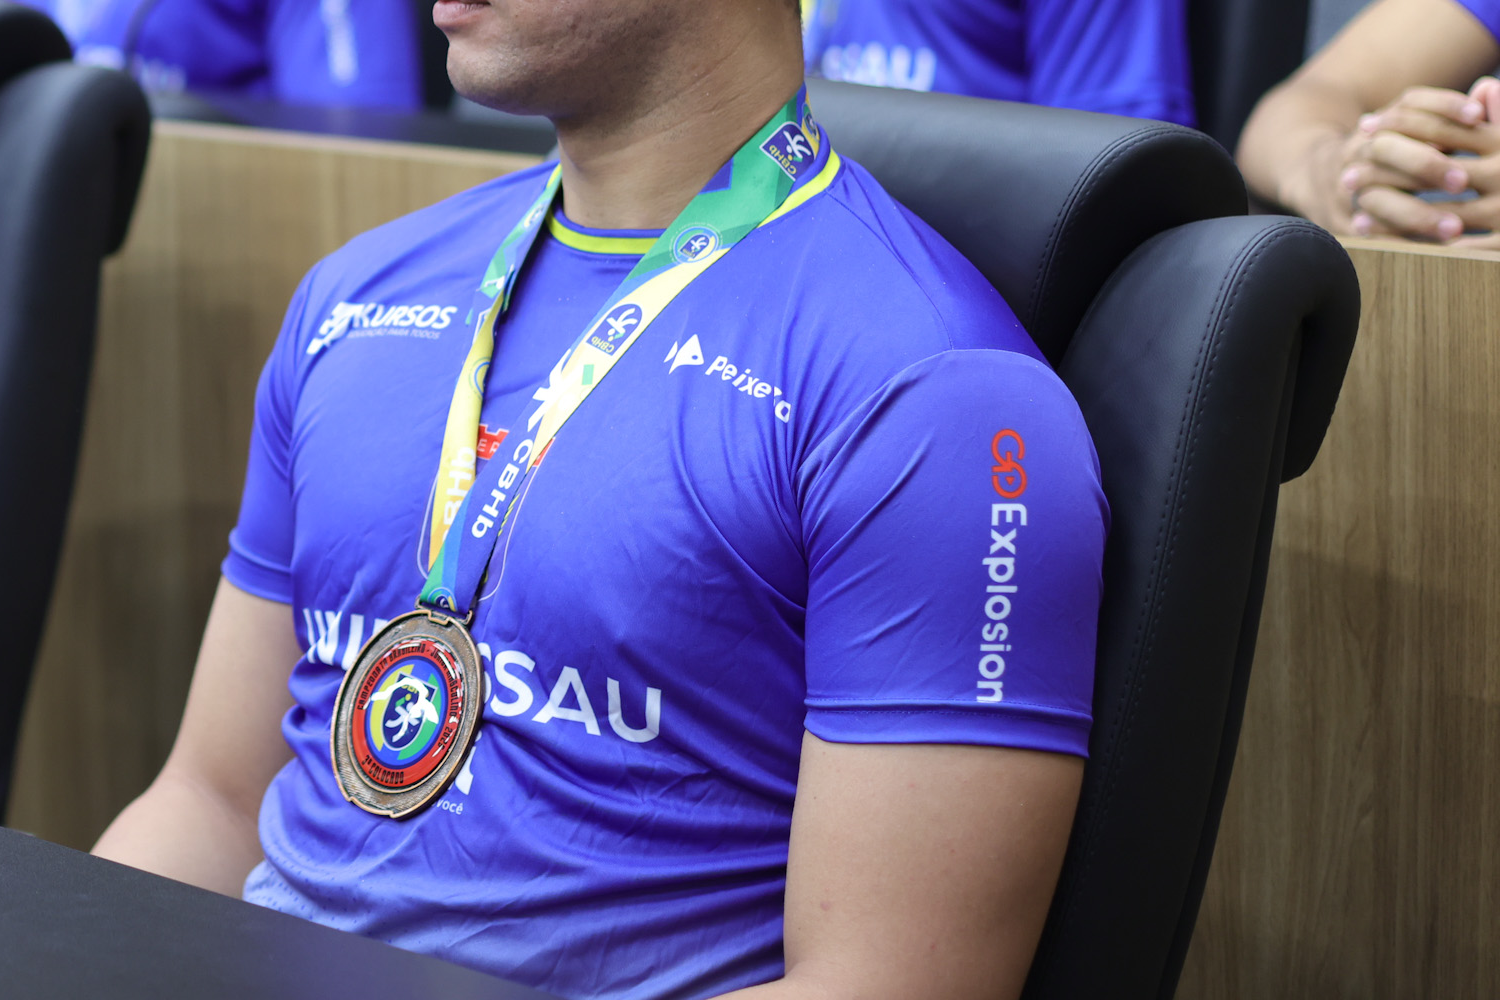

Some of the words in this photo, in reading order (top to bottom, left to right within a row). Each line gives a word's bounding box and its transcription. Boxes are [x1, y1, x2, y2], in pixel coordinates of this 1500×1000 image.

[769, 145, 797, 175] CBHb
[591, 336, 615, 353] CBHb
[471, 439, 535, 539] CBHb
[976, 503, 1028, 703] Explosion
